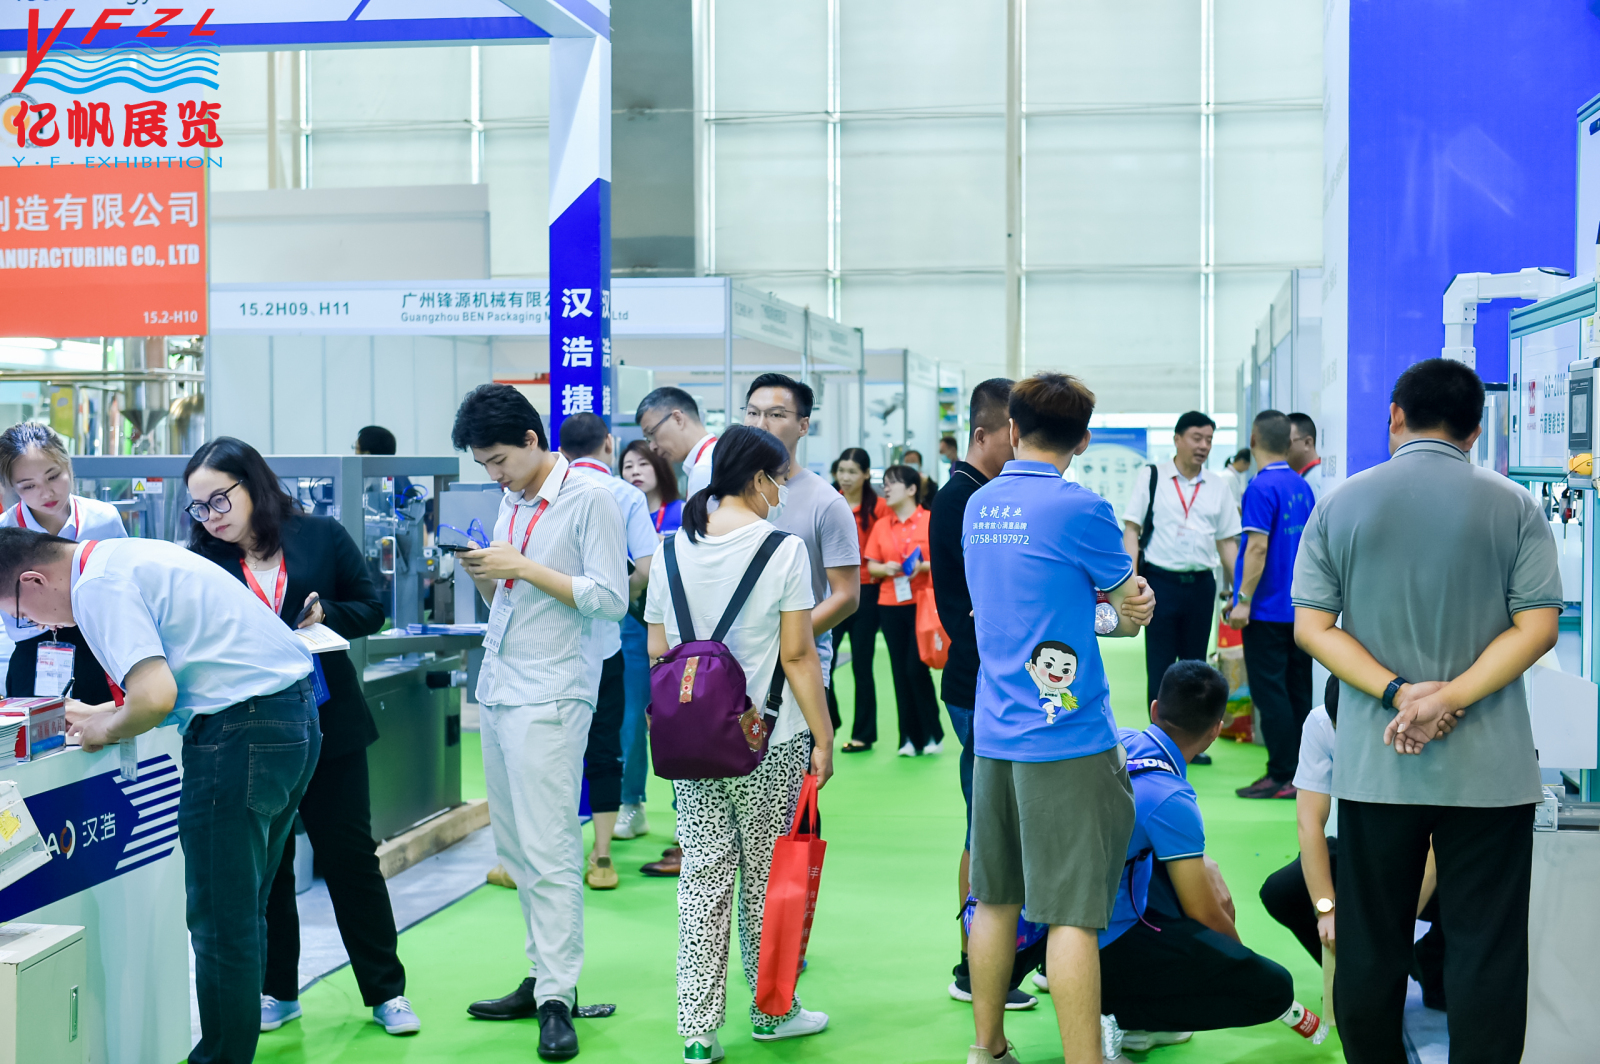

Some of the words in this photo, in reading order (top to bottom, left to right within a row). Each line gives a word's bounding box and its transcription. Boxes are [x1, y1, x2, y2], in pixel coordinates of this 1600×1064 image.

[131, 245, 165, 267] CO.,
[168, 244, 200, 265] LTD
[143, 310, 199, 324] 15.2-H10
[401, 311, 460, 324] Guangzhou
[462, 312, 484, 322] BEN
[487, 311, 541, 323] Packaging
[612, 311, 629, 320] Ltd
[561, 288, 594, 416] 汉浩捷
[970, 533, 1030, 545] 0758-8197972
[82, 811, 116, 848] 汉浩
